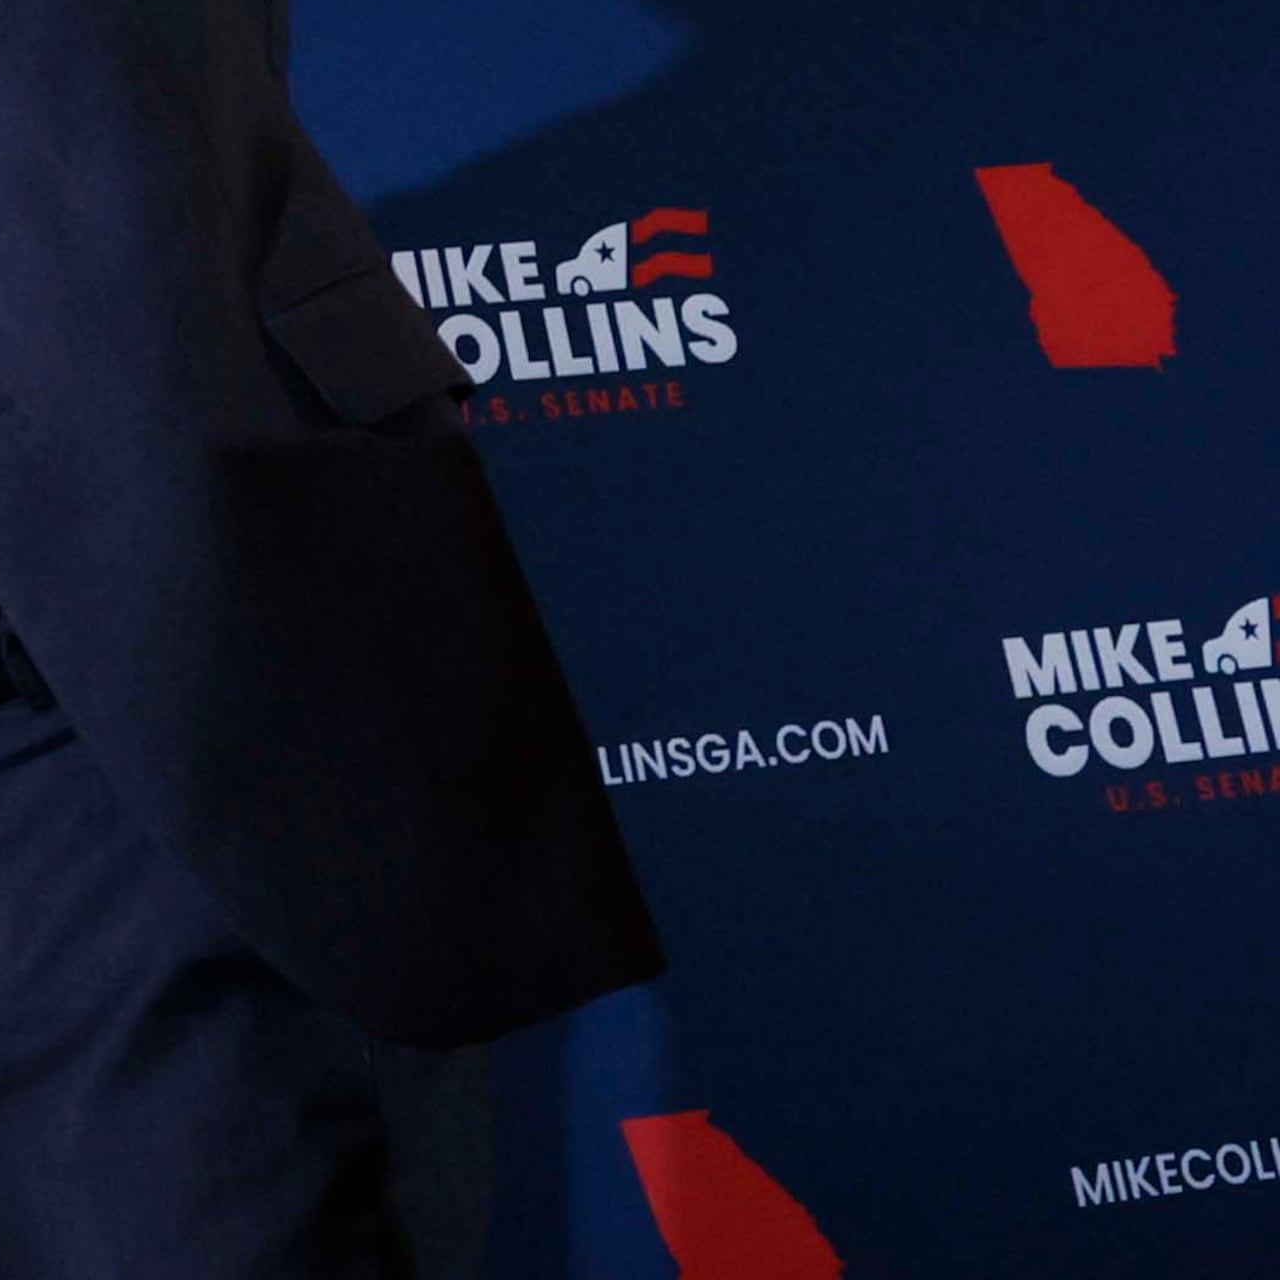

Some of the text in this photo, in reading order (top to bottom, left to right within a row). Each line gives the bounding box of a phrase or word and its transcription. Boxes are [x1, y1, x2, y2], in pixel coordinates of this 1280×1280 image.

[541, 380, 685, 418] SENATE
[1001, 618, 1195, 700] MIKE
[597, 714, 890, 787] LINSGA.COM
[1025, 677, 1280, 778] COLLI
[1105, 780, 1187, 813] U.S.
